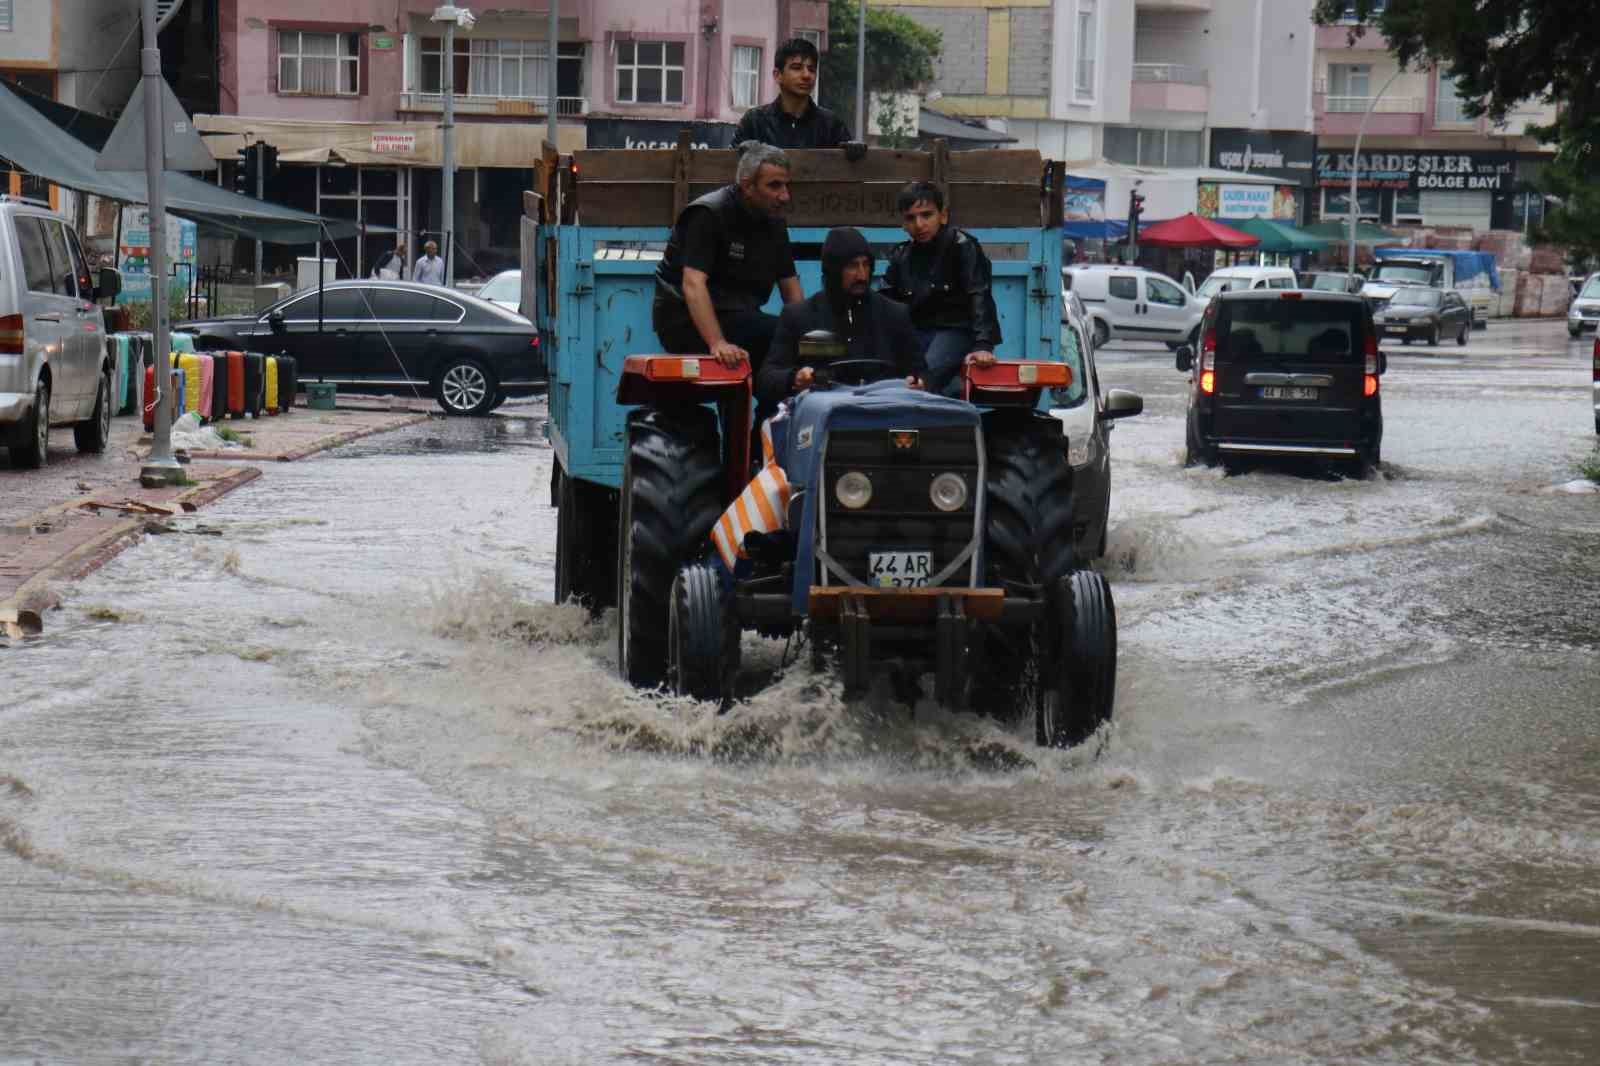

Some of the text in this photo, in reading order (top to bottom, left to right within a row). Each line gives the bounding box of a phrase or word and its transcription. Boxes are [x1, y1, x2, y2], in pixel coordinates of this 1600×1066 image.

[1417, 173, 1501, 189] BÖLGE BAYİ
[873, 555, 930, 574] 44 AR
